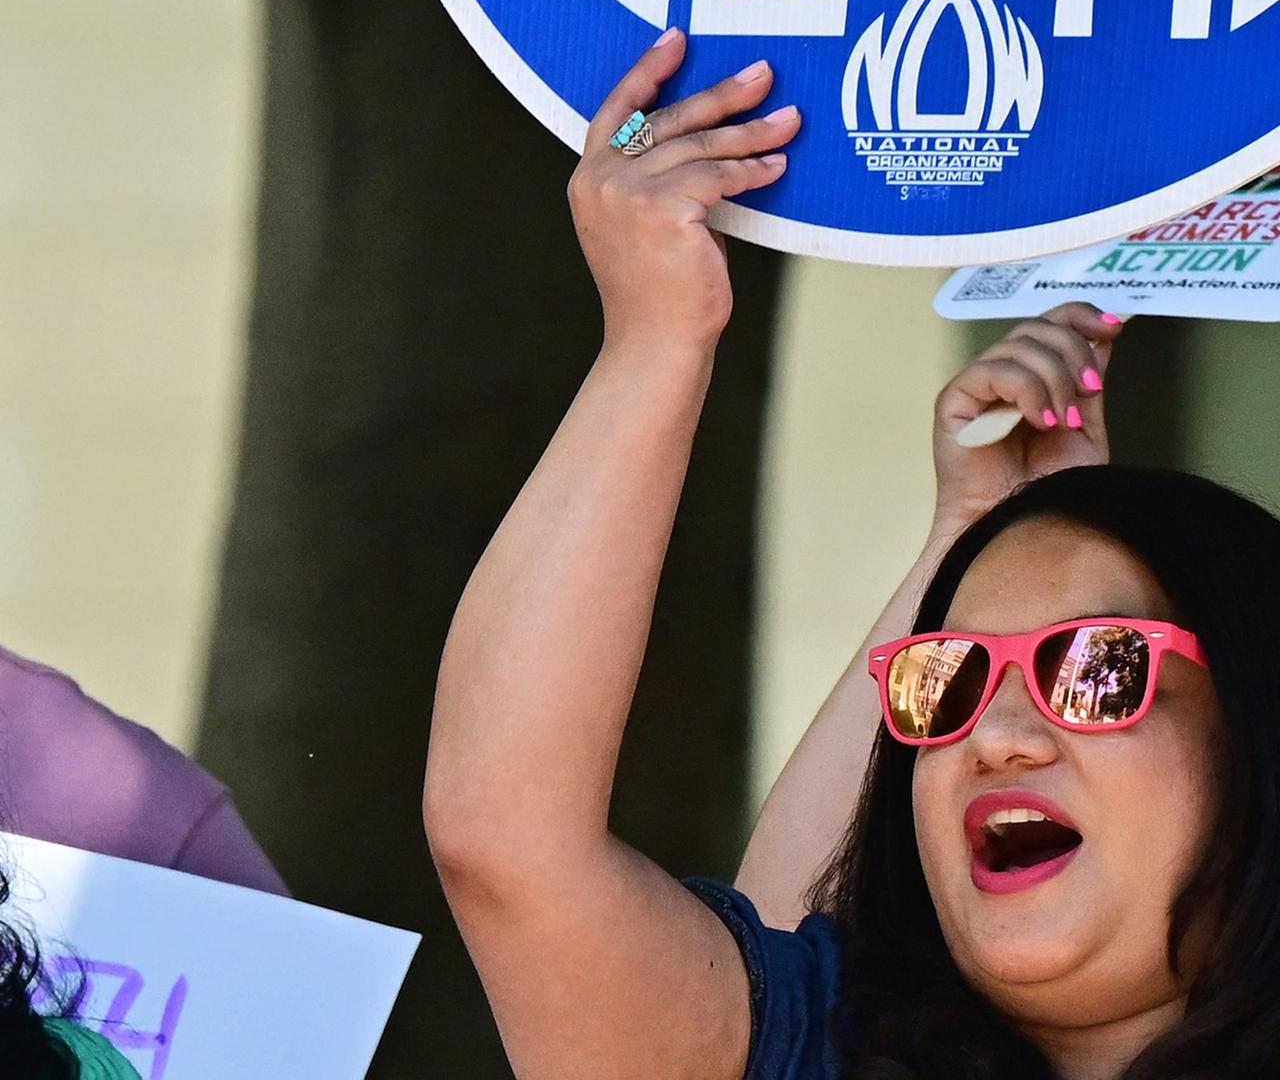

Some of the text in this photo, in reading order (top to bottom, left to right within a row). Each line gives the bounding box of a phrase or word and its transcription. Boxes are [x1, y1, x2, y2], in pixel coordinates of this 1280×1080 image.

[855, 137, 1020, 151] NATIONAL
[866, 155, 1003, 168] ORGANIZATION
[885, 171, 985, 181] FOR WOMEN
[1086, 248, 1262, 272] ACTION
